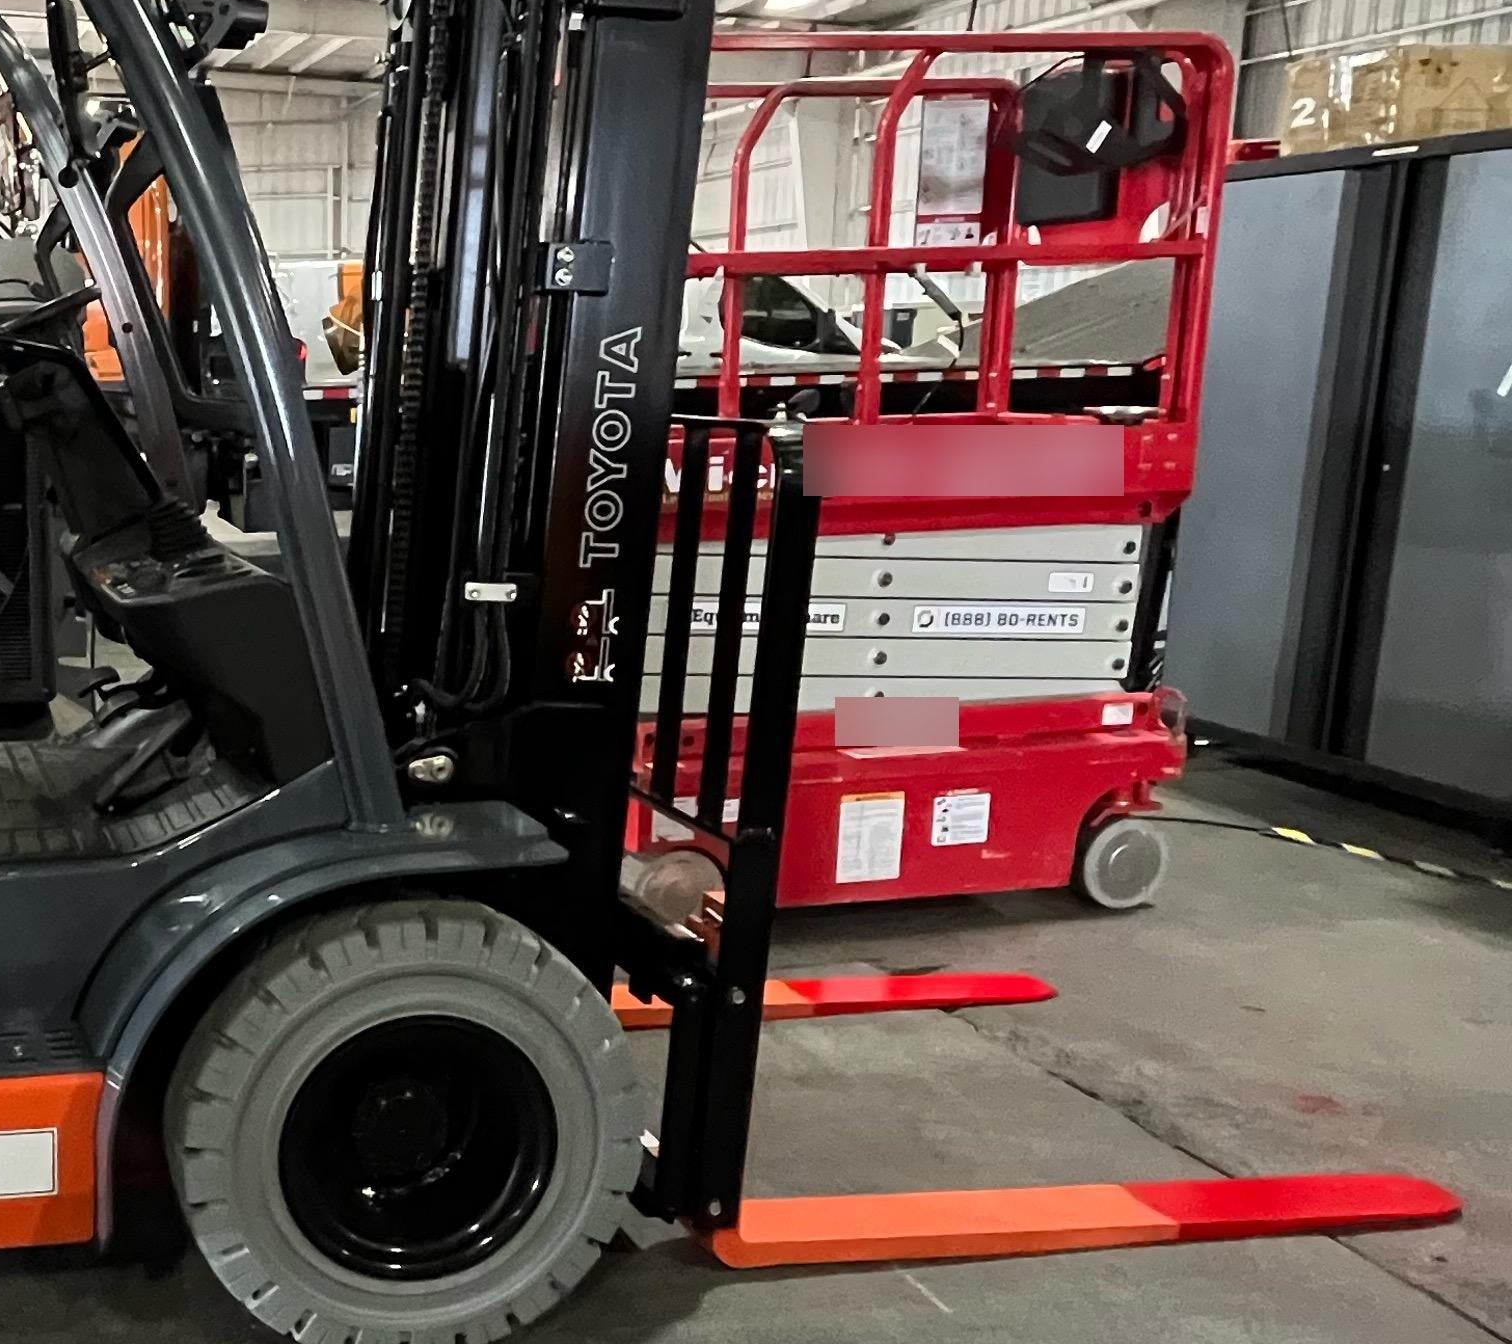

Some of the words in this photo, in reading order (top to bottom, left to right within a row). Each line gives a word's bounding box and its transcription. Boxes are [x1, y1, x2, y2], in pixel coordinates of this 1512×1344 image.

[579, 326, 643, 568] TOYOTA
[944, 611, 991, 628] (888)
[997, 612, 1079, 628] 80-RENTS
